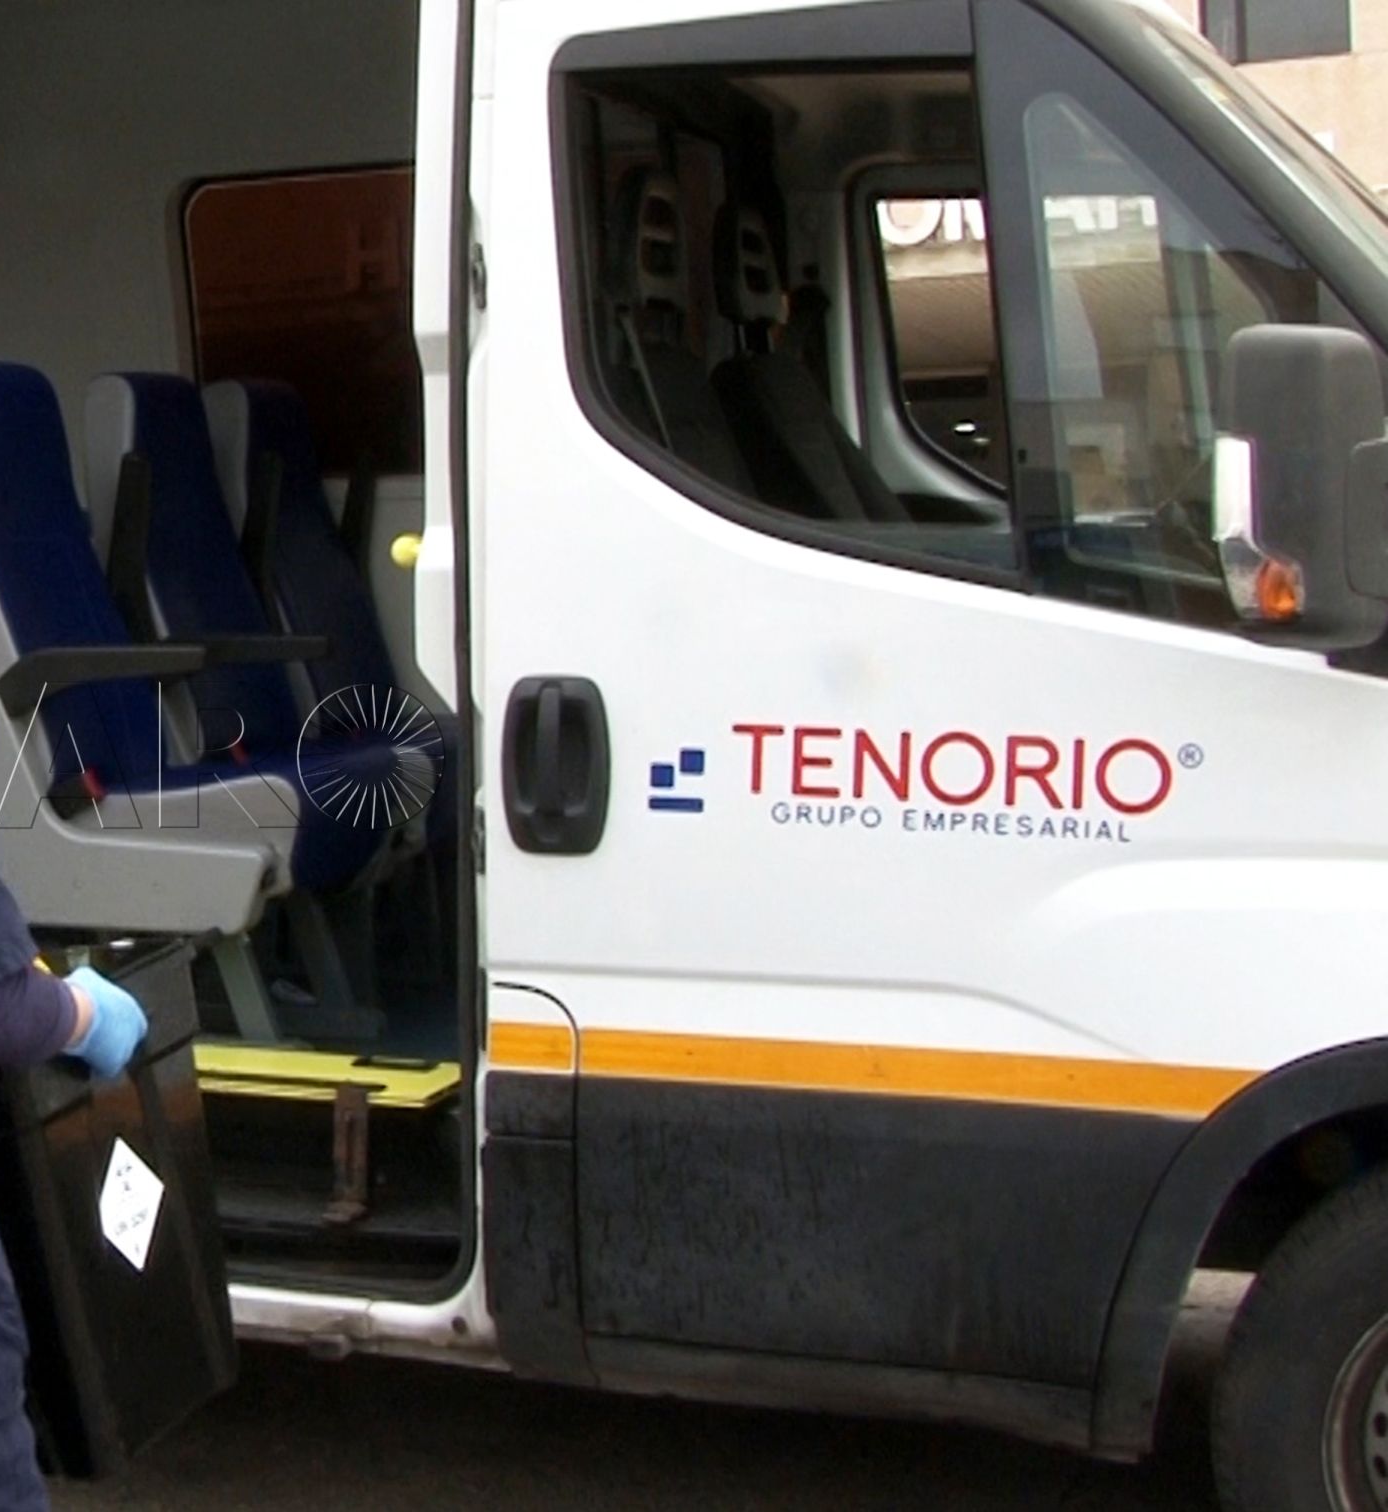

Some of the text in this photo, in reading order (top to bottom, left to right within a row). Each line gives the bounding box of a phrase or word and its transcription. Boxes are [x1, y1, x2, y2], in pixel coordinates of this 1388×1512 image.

[732, 724, 1172, 815] TENORIO
[770, 801, 1133, 843] GRUPO EMPRESARIAL
